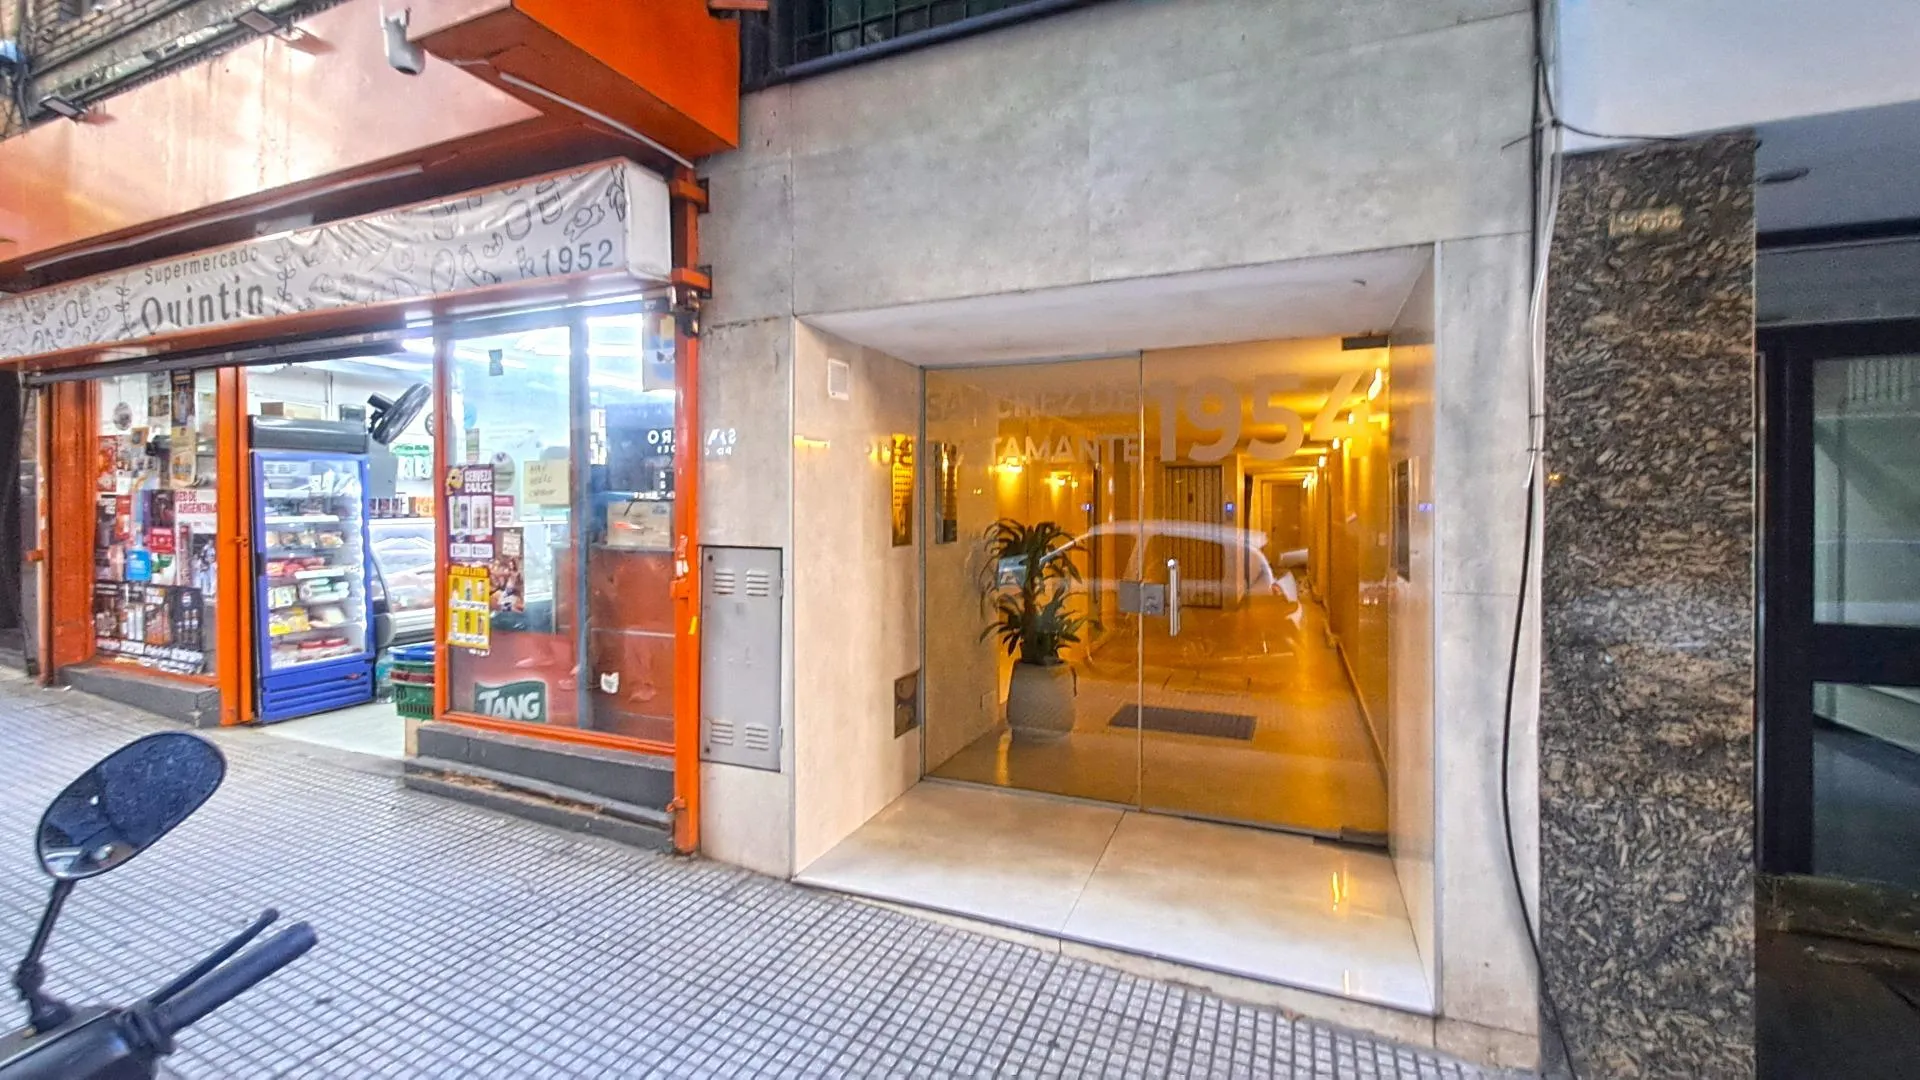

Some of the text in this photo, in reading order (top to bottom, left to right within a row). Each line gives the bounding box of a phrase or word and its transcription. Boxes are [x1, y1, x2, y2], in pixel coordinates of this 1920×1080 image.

[145, 245, 258, 286] Supermercado
[542, 239, 613, 276] 1952
[1148, 371, 1381, 464] 1954
[465, 482, 492, 493] DULCE
[479, 690, 540, 720] TANG
